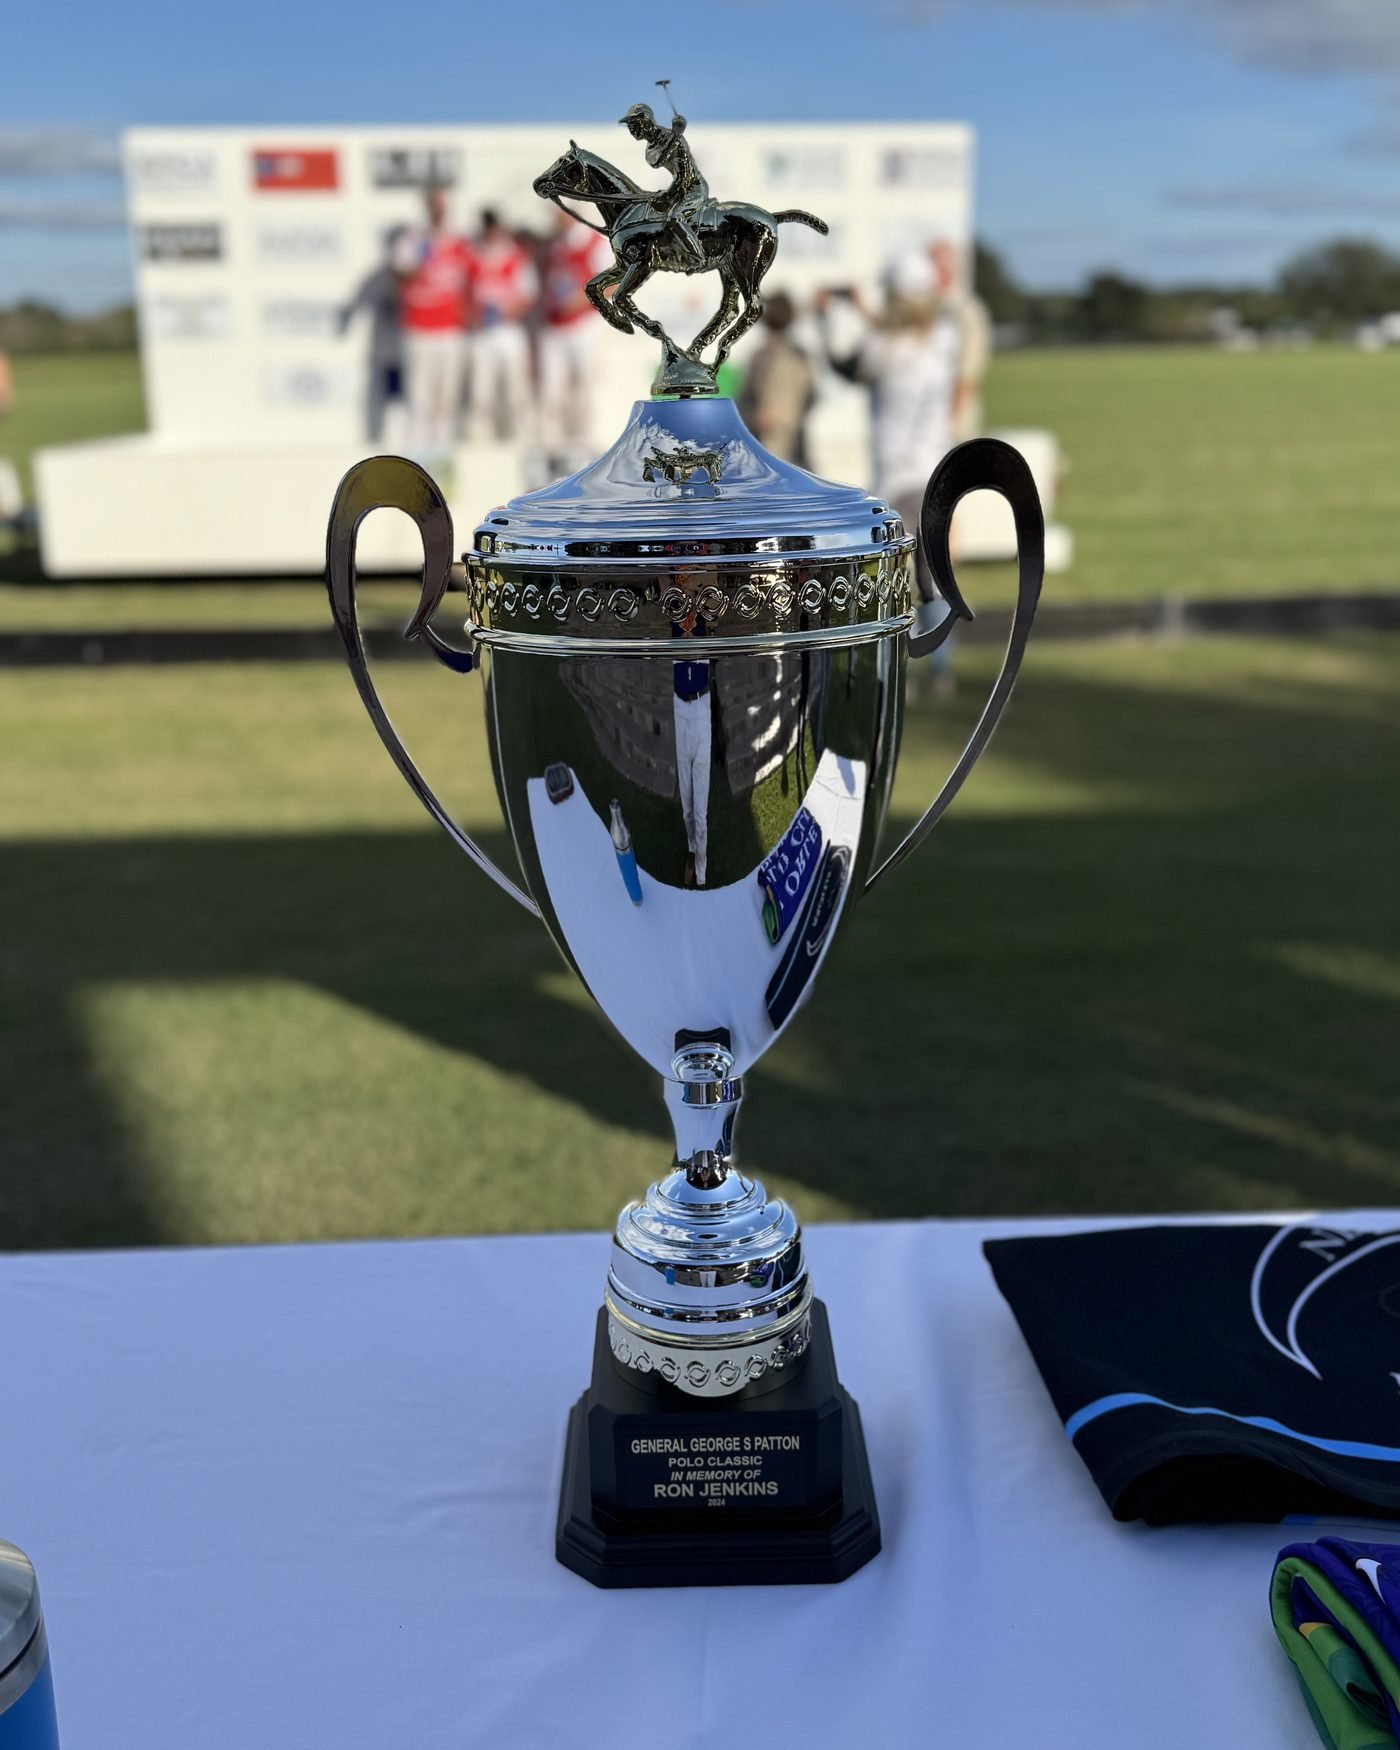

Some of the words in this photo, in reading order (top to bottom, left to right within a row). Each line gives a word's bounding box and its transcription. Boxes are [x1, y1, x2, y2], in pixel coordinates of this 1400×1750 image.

[631, 1438, 688, 1454] GENERAL
[690, 1436, 741, 1452] GEORGE
[743, 1436, 752, 1451] S
[754, 1435, 800, 1450] PATTON
[668, 1457, 704, 1467] POLO
[707, 1456, 763, 1466] CLASSIC
[670, 1471, 683, 1481] IN
[686, 1470, 741, 1481] MEMORY
[743, 1469, 762, 1479] OF
[653, 1483, 694, 1498] RON
[699, 1481, 778, 1496] JENKINS
[708, 1498, 726, 1506] 2024
